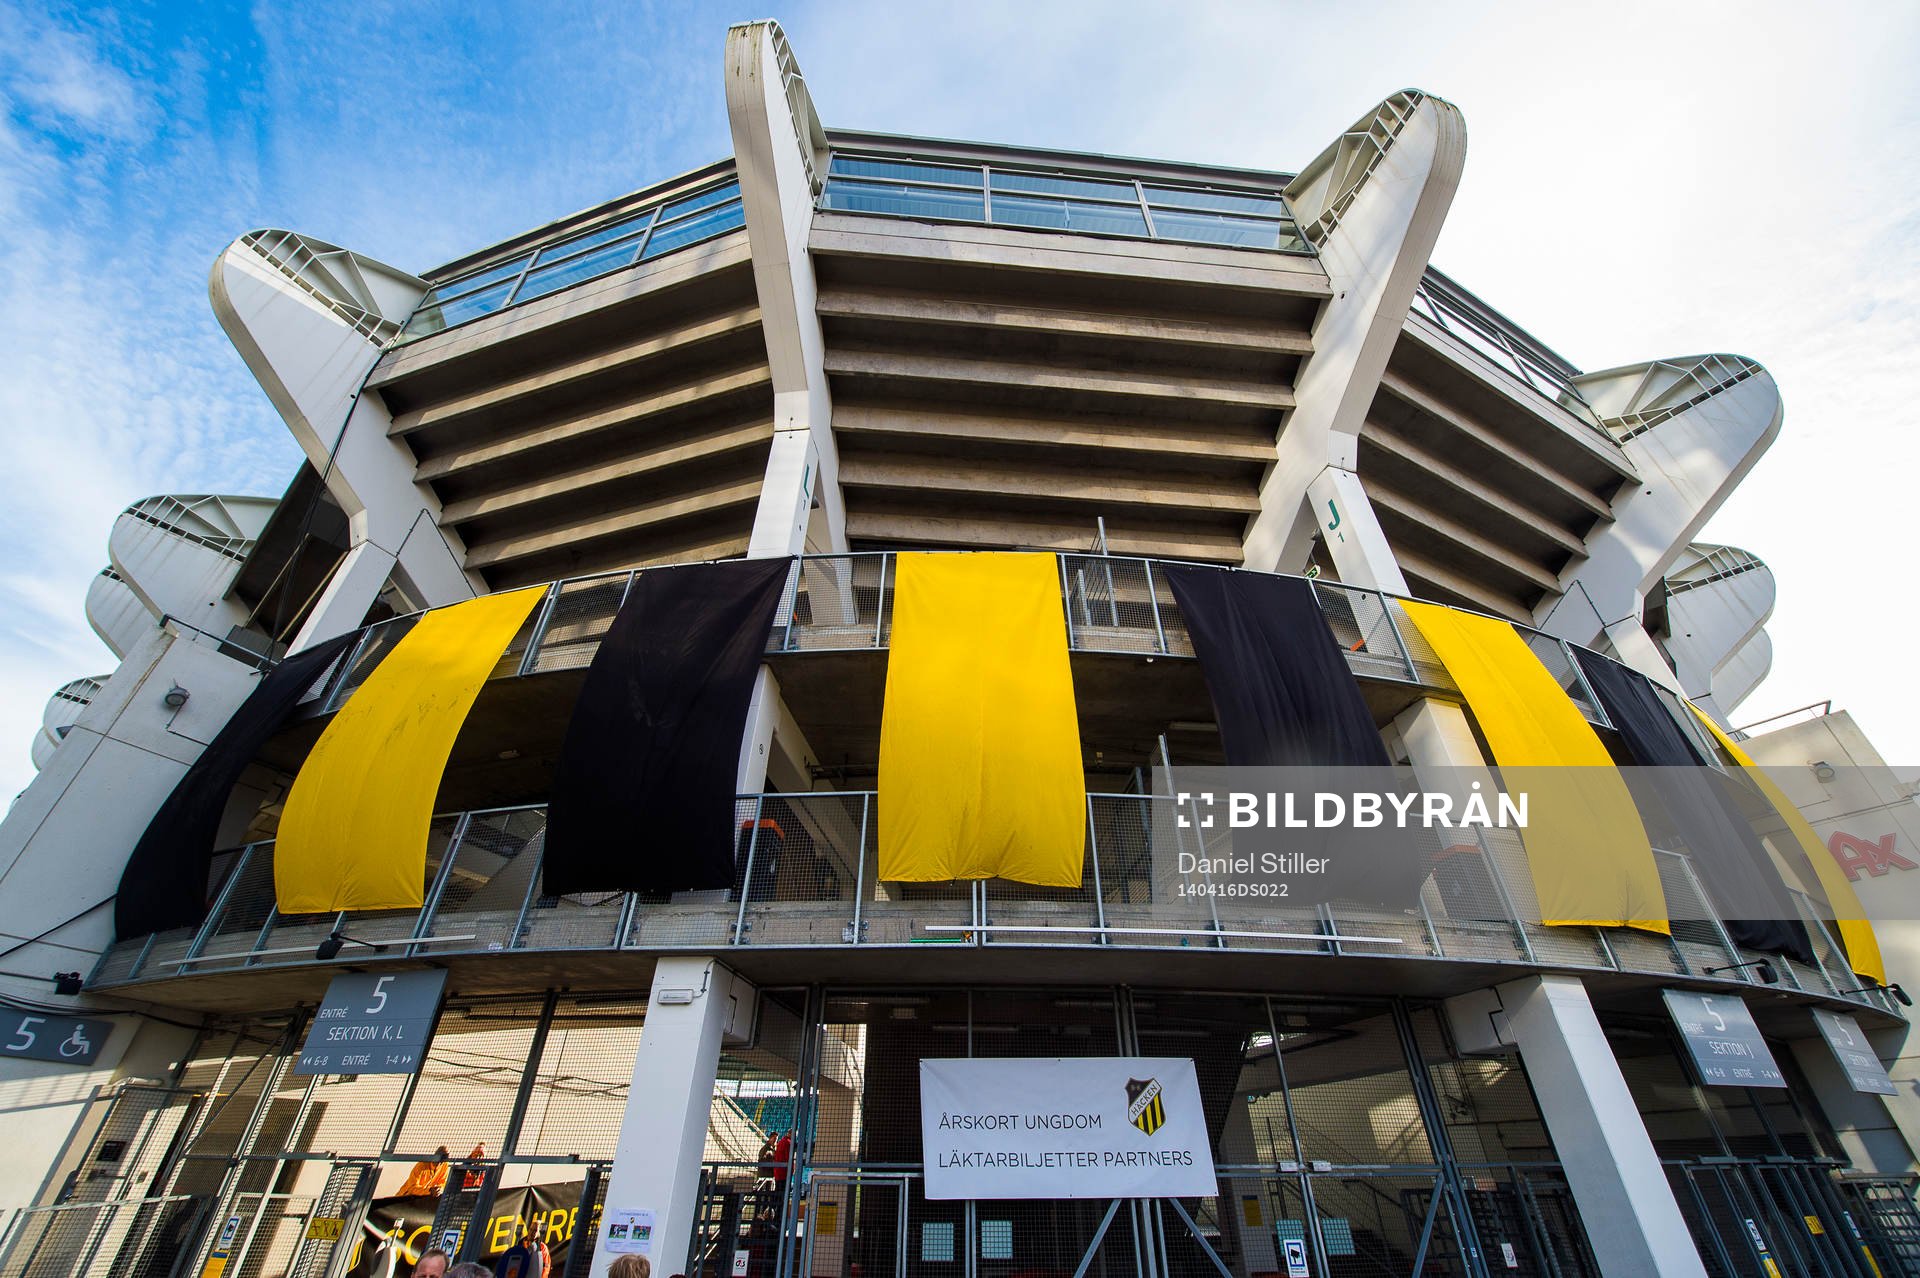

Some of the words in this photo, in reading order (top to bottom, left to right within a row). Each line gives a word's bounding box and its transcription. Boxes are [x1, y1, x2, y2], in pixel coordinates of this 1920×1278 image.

[1327, 498, 1341, 531] J
[1337, 531, 1345, 543] 1
[365, 975, 396, 1014] 5
[320, 1006, 349, 1019] ENTRÉ
[1701, 996, 1727, 1032] 5
[6, 1016, 46, 1051] 5
[326, 1025, 379, 1041] SEKTION
[396, 1025, 404, 1039] L
[1708, 1041, 1747, 1056] SEKTION
[341, 1054, 371, 1066] ENTRÉ
[1131, 1084, 1158, 1116] HÄCKEN
[938, 1112, 1019, 1130] ÅRSKORT
[1024, 1114, 1102, 1130] UNGDOM
[938, 1149, 1098, 1168] LÄKTARBILJETTER
[1104, 1150, 1193, 1167] PARTNERS
